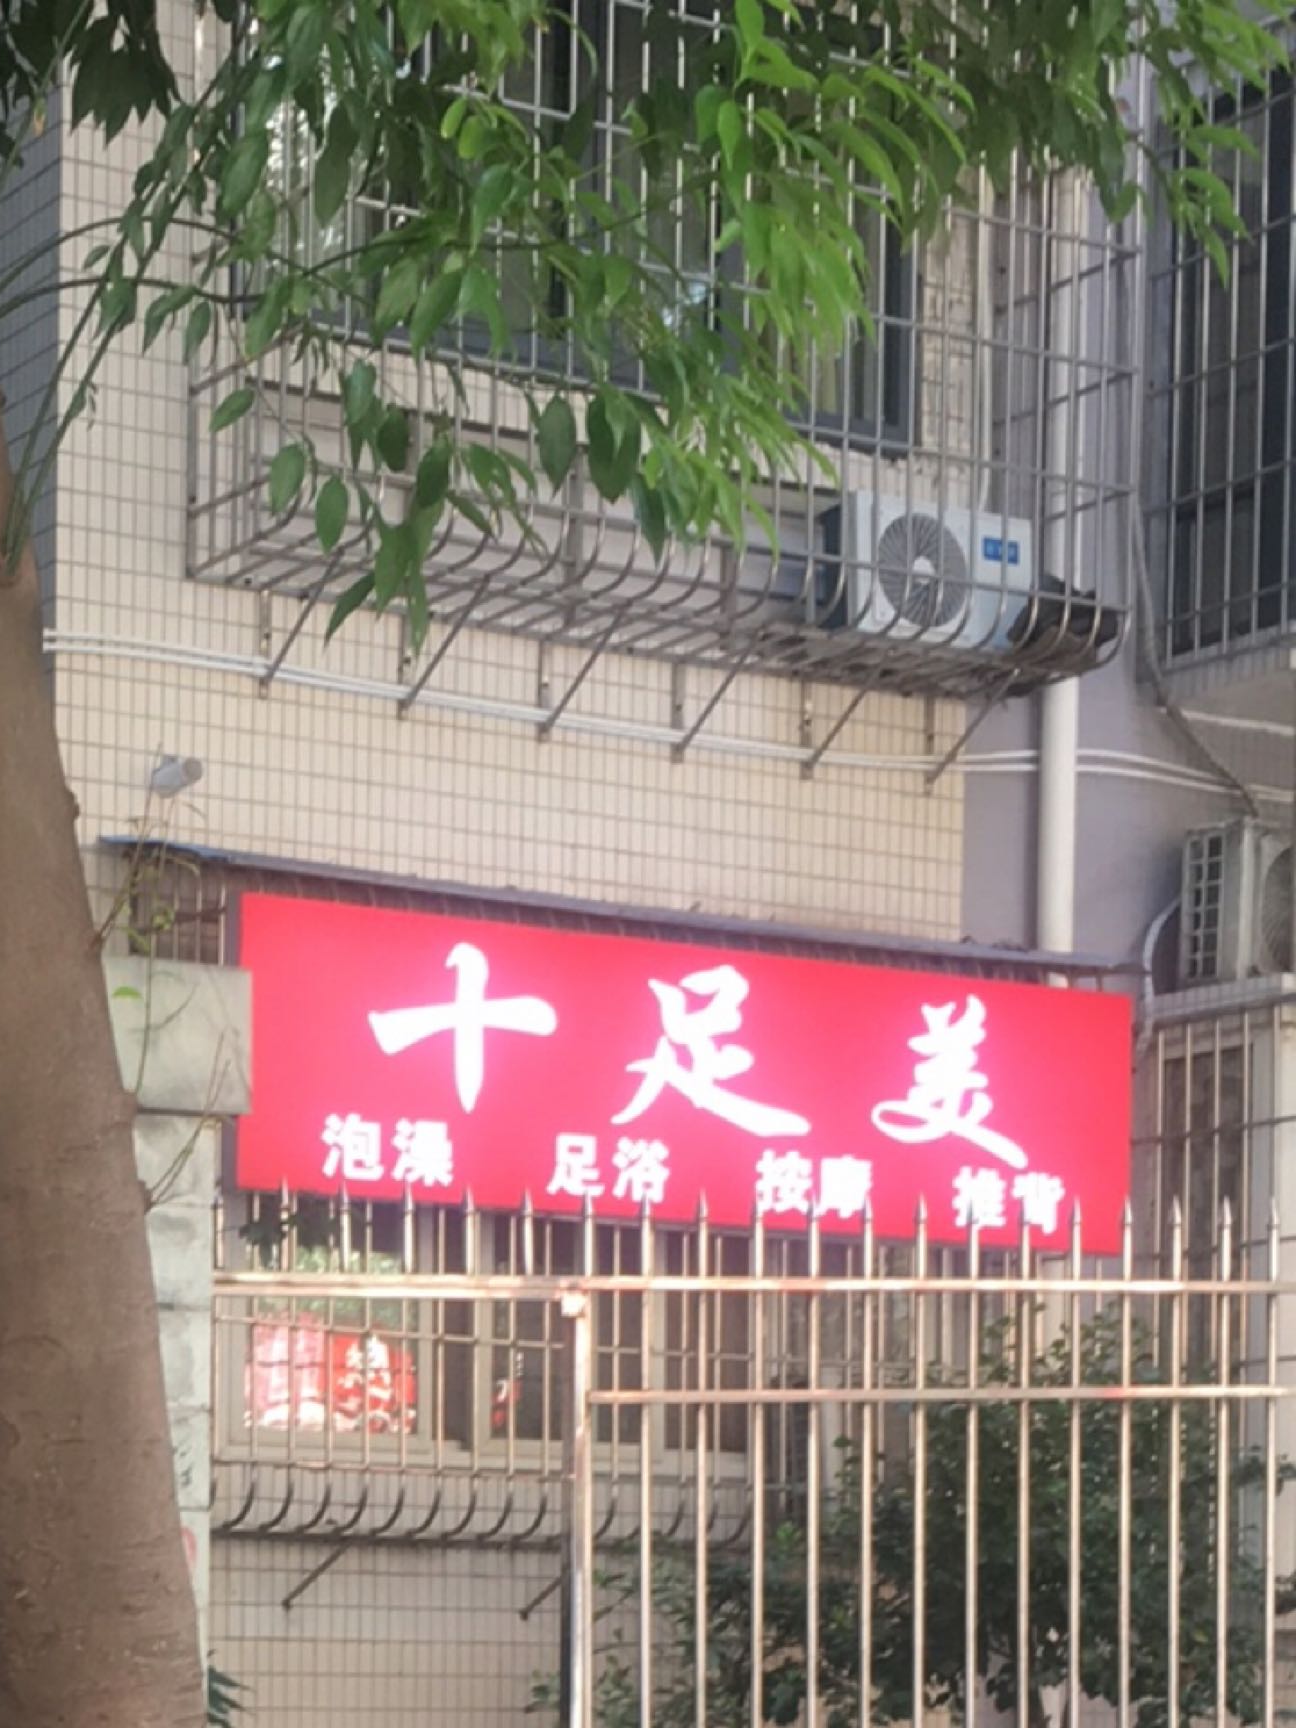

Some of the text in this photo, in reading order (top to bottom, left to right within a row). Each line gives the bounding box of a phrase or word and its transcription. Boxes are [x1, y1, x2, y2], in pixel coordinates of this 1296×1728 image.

[368, 942, 1028, 1168] 十足美
[320, 1113, 454, 1186] 泡澡
[546, 1132, 670, 1203] 足浴
[755, 1149, 873, 1219] 按摩
